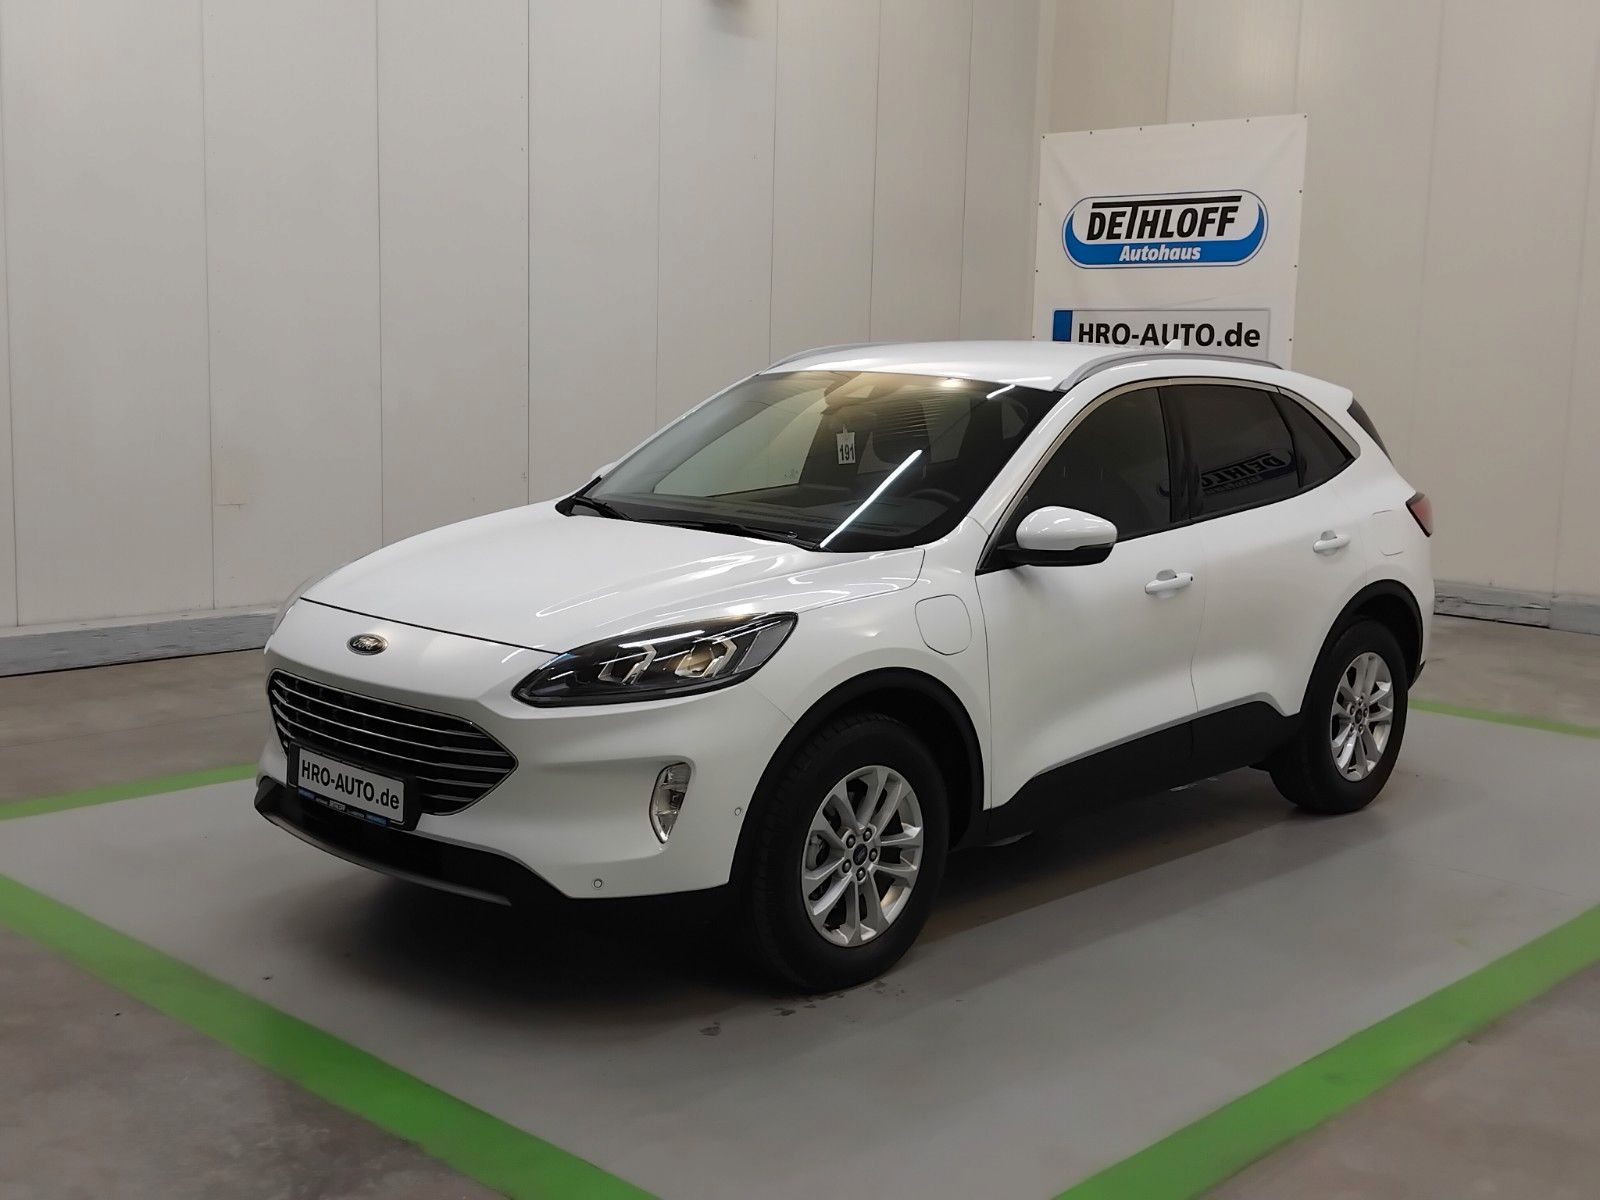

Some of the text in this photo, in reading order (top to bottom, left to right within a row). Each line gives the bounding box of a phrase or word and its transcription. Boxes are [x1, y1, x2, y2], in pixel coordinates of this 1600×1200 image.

[1086, 195, 1242, 241] DETHLOFF
[1119, 245, 1202, 262] Autohaus
[1078, 322, 1261, 347] HRO-AUTO.de
[839, 443, 855, 461] 191
[302, 759, 400, 810] HRO-AUTO.de
